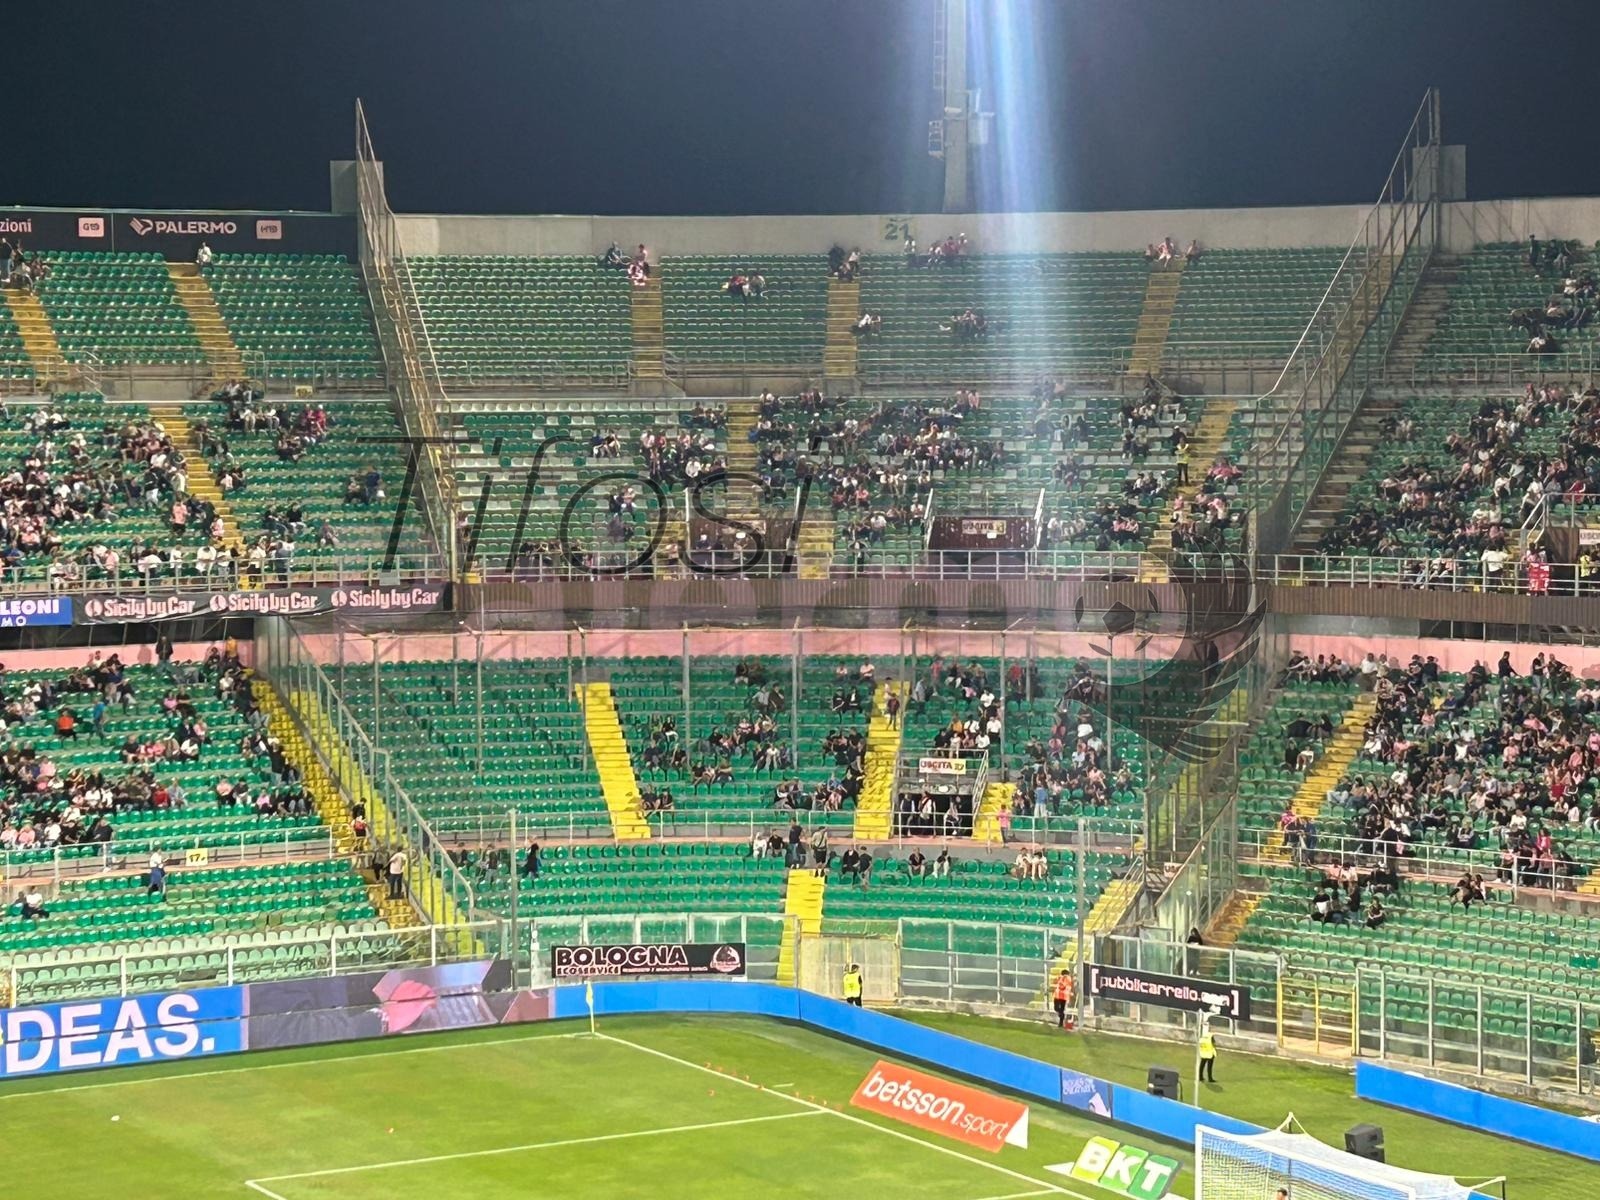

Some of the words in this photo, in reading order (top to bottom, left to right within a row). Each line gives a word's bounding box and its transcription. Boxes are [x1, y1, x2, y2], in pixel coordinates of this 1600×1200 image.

[155, 221, 237, 234] PALERMO
[0, 599, 60, 615] LEONI
[555, 945, 689, 966] BOLOGNA
[6, 993, 215, 1073] DEAS.
[1076, 1141, 1173, 1192] BKT
